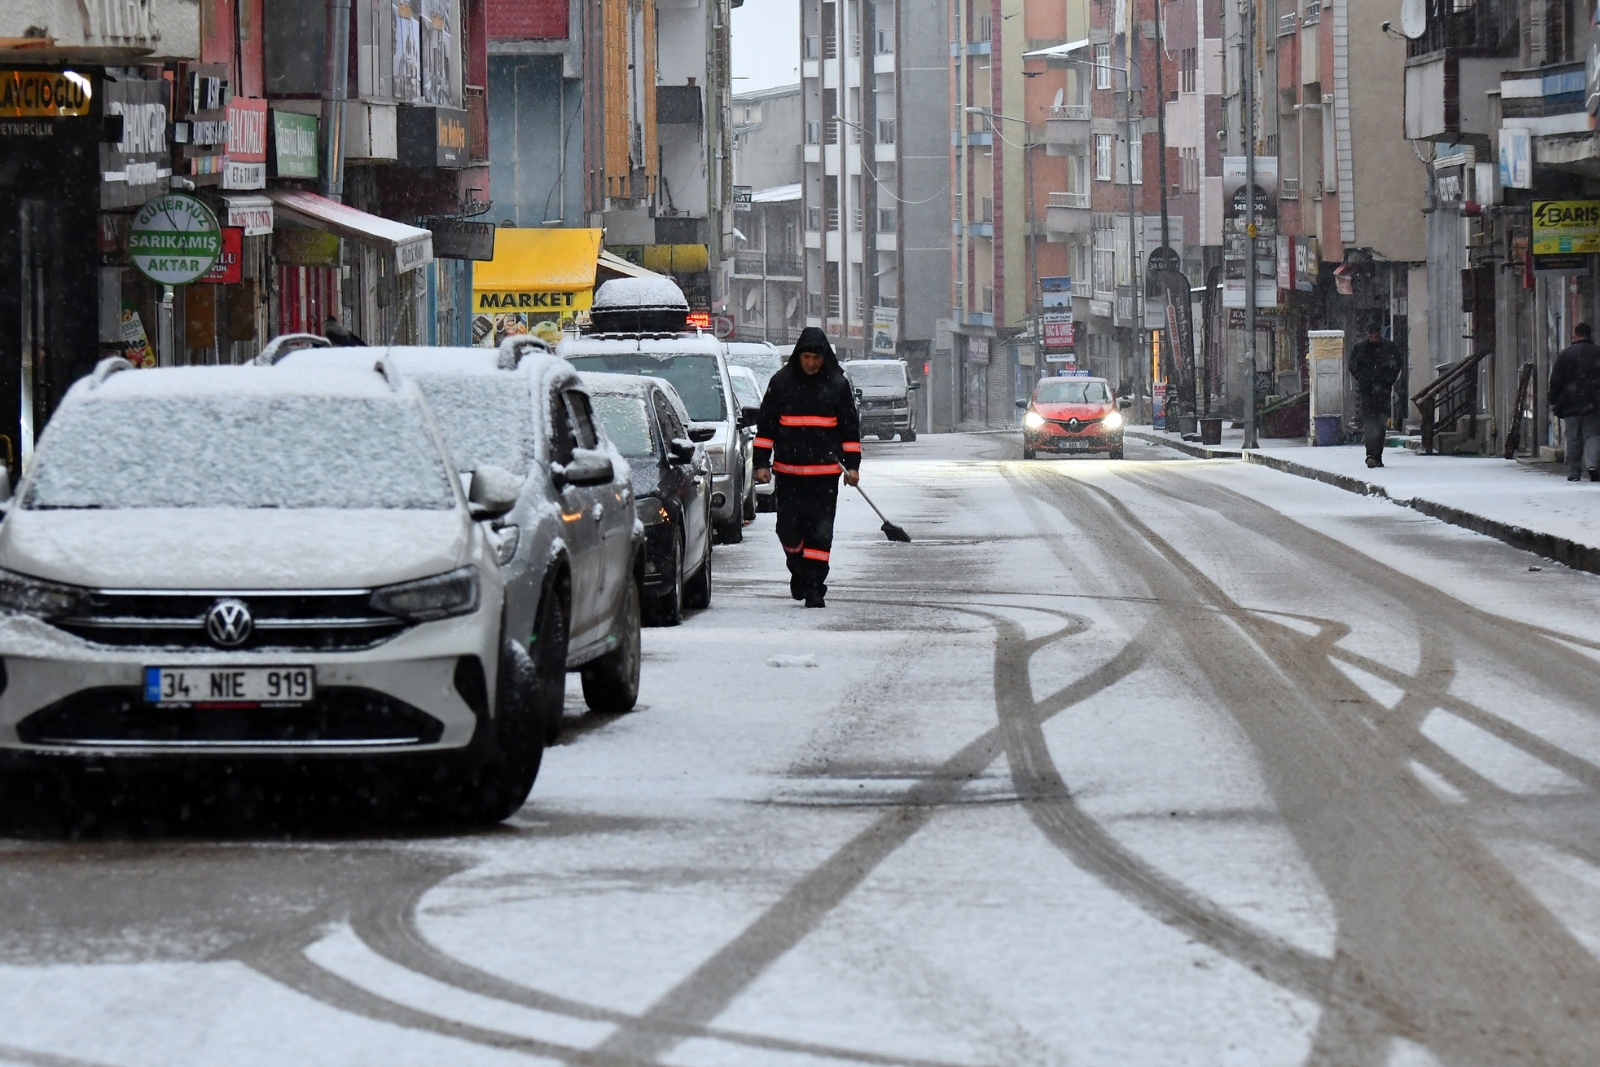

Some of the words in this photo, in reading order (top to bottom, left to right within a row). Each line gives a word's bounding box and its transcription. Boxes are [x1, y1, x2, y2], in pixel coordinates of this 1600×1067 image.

[139, 199, 210, 228] GÜLERYÜZ
[1548, 205, 1600, 225] BARIŞ
[129, 235, 217, 252] SARIKAMIŞ
[147, 258, 200, 272] AKTAR
[479, 291, 575, 308] MARKET
[163, 672, 190, 698] 34
[210, 672, 246, 698] NIE
[267, 671, 307, 697] 919
